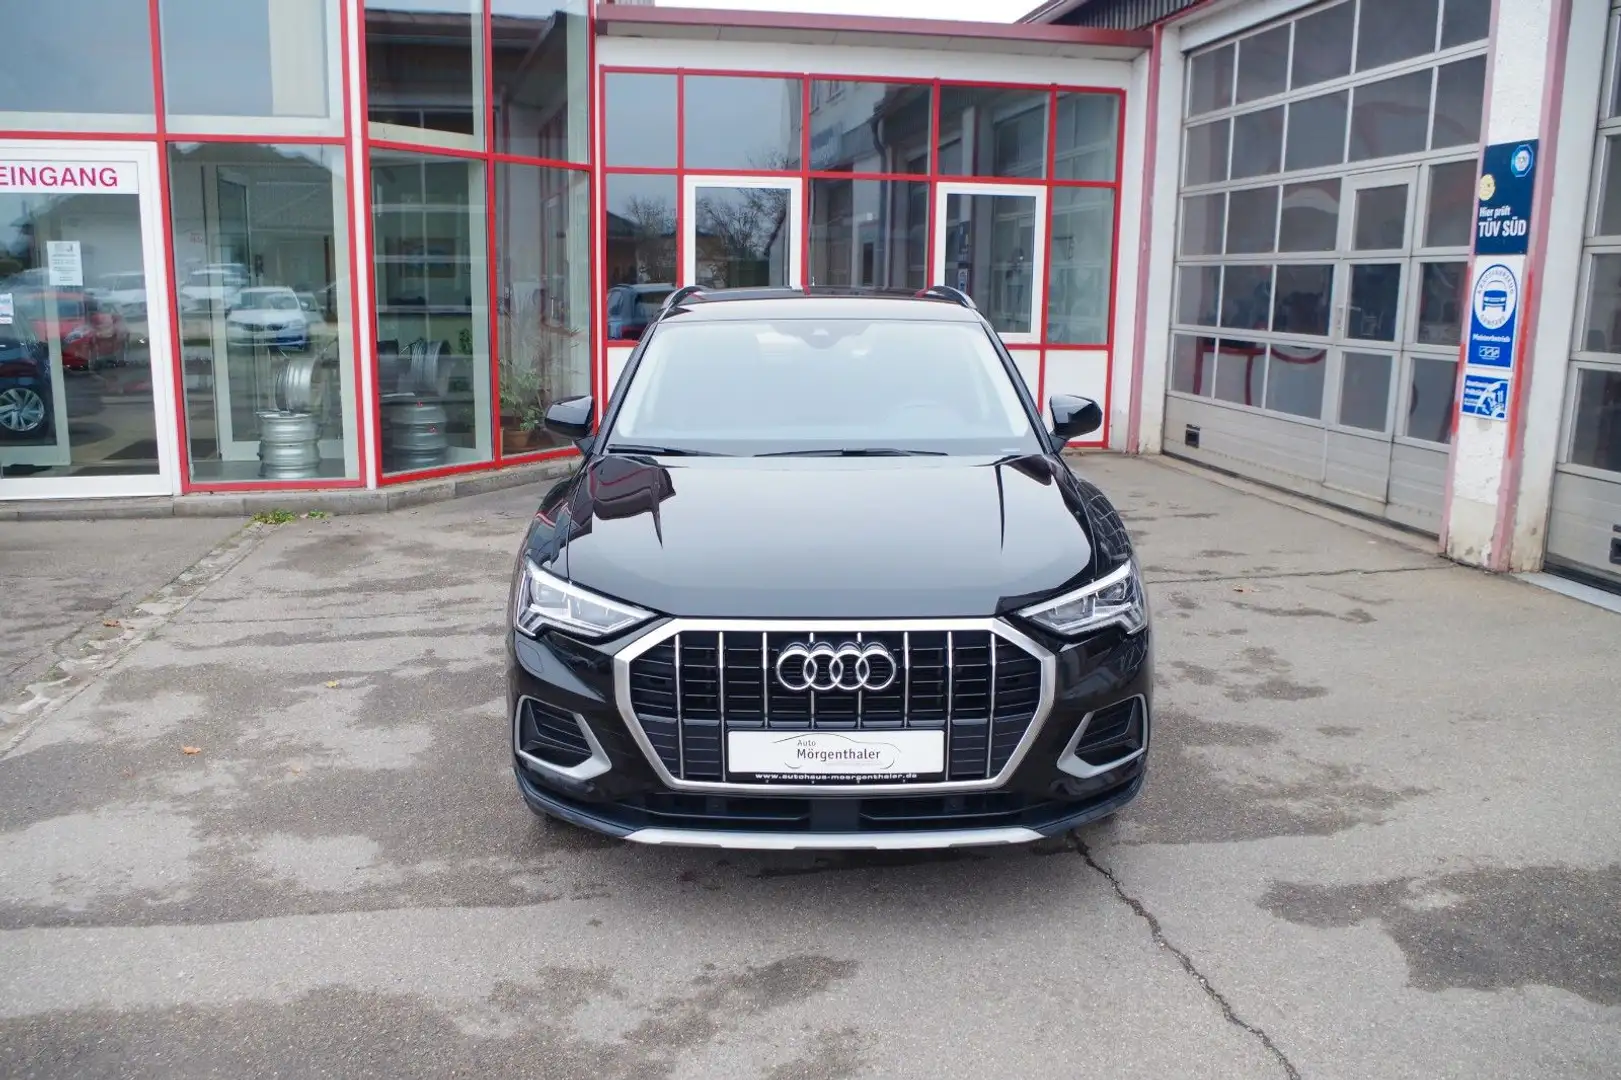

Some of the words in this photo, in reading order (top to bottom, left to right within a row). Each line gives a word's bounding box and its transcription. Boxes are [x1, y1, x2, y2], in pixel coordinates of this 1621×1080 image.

[0, 166, 117, 187] EINGANG
[1479, 206, 1494, 217] Hier
[1494, 204, 1511, 218] prüft
[1478, 217, 1501, 237] TÜV
[1502, 216, 1527, 237] SÜD
[797, 739, 817, 747] Auto
[797, 748, 881, 762] Mörgenthaler
[755, 772, 918, 781] www.autohaus-moergenthaler.de
